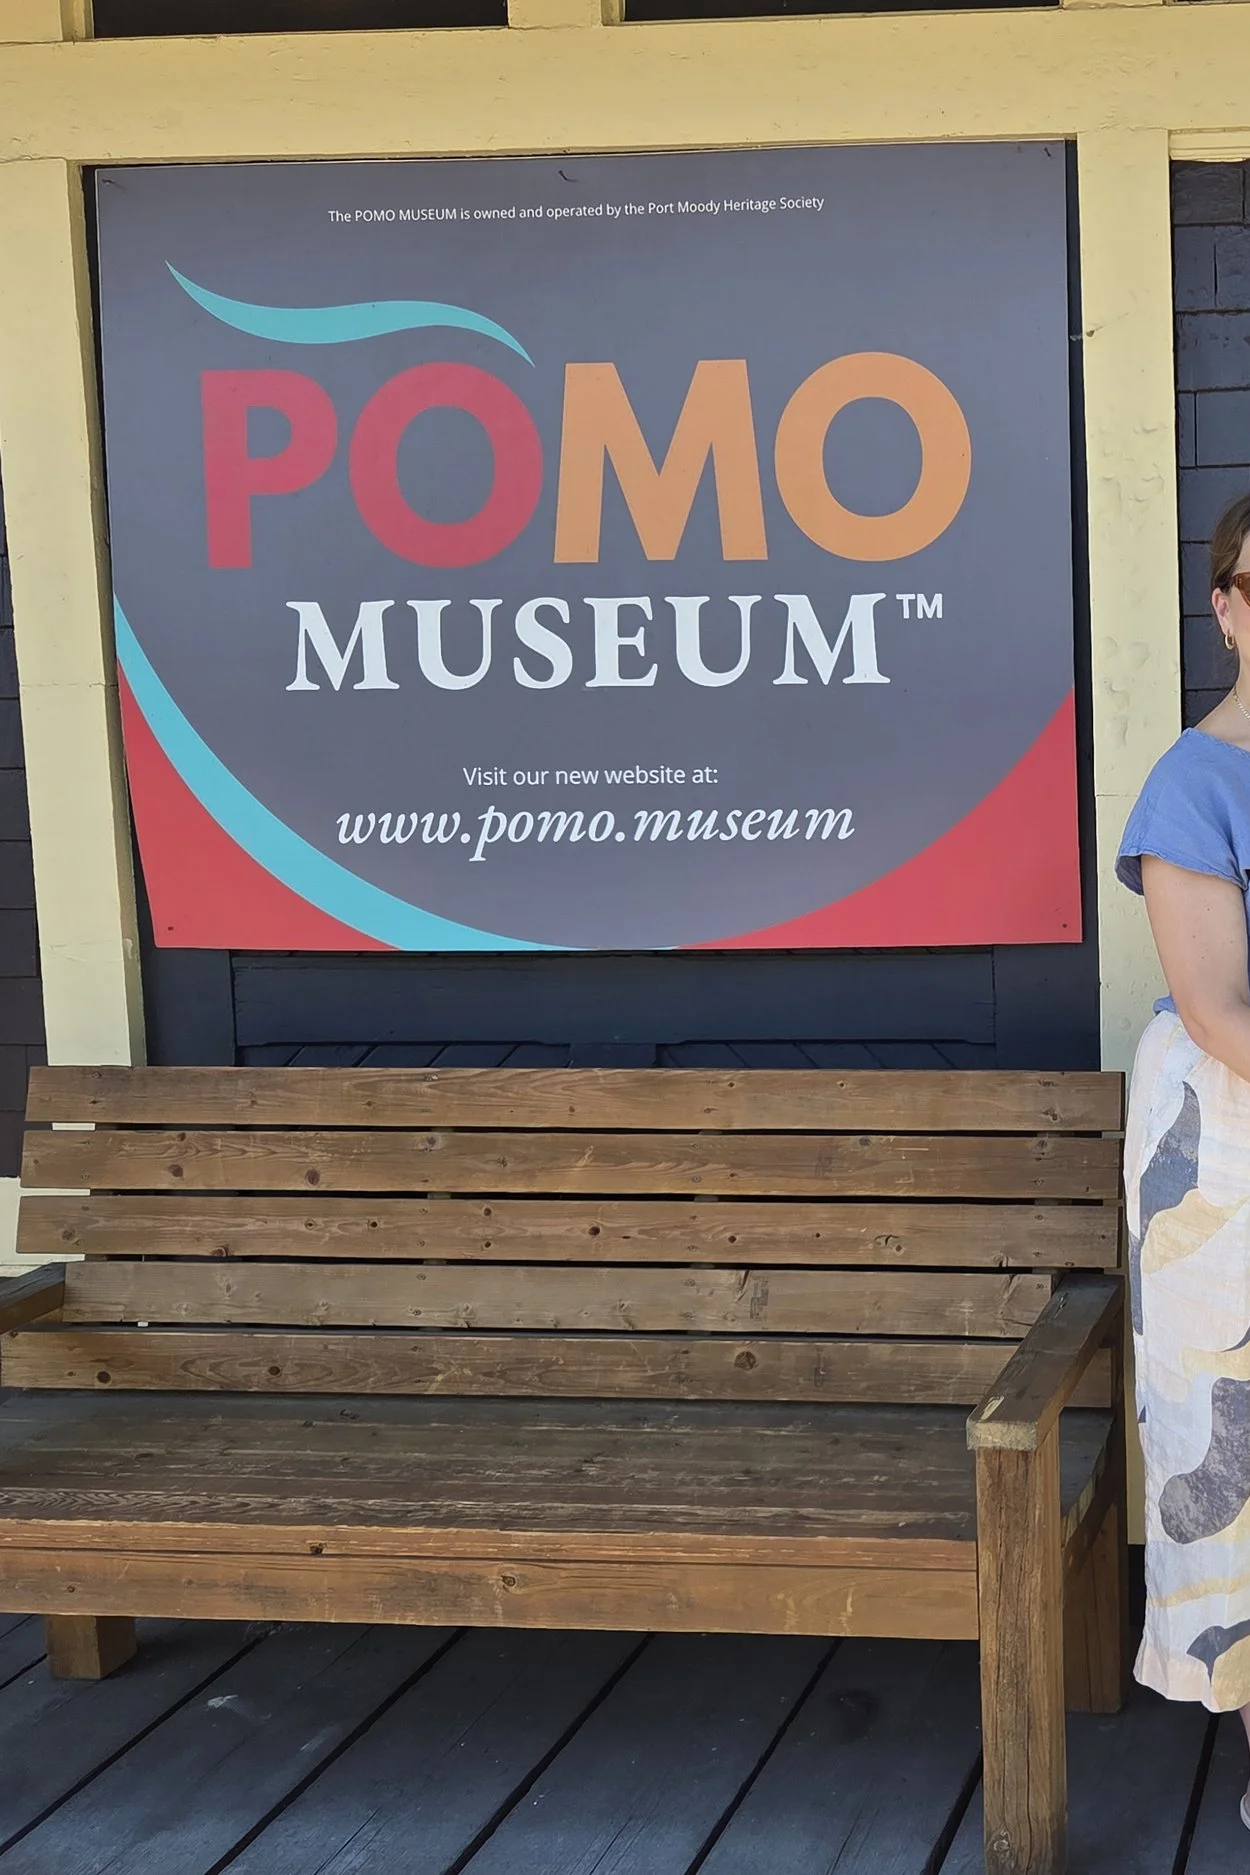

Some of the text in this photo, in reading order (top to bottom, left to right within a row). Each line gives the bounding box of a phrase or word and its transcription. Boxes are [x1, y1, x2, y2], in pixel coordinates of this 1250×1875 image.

[328, 196, 825, 222] The POMO MUSEUM is owned and operated by the Port Moody Heritage Society
[201, 351, 972, 569] POMO
[285, 592, 891, 692] MUSEUM
[462, 764, 719, 787] Visit our new website at:
[335, 804, 857, 862] www.pomo.museum
